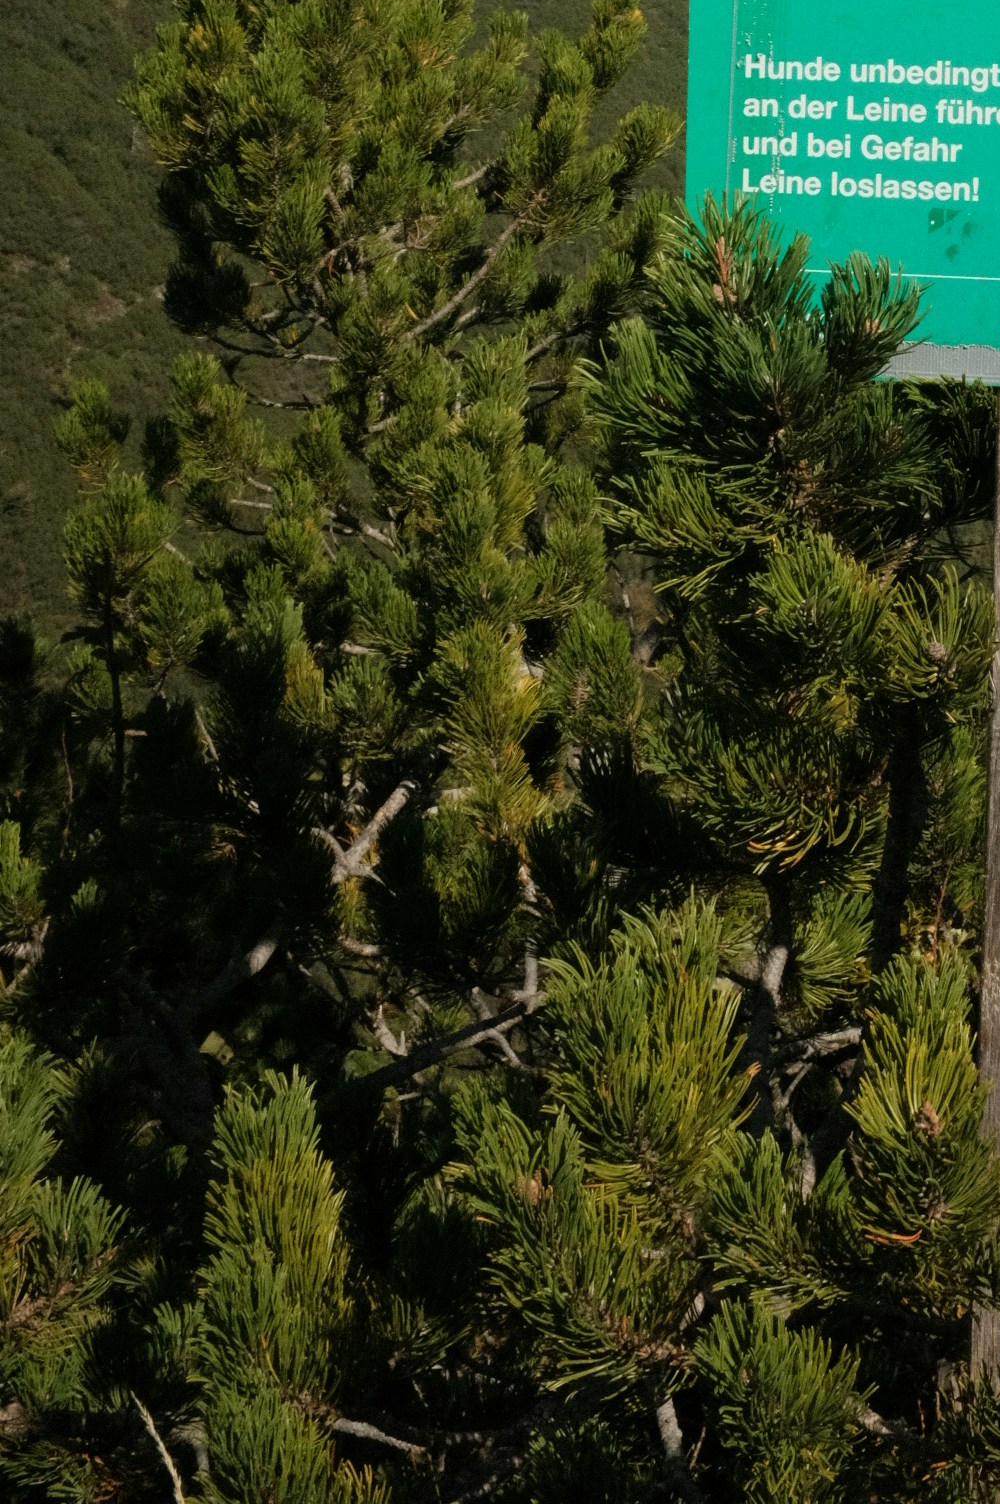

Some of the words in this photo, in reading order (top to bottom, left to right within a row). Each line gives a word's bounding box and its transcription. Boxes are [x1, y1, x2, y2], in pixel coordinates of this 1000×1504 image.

[744, 53, 842, 82] Hunde
[742, 97, 779, 118] an
[788, 93, 838, 120] der
[846, 95, 927, 123] Leine
[742, 132, 798, 157] und
[807, 132, 852, 159] bei
[860, 134, 963, 163] Gefahr
[741, 168, 822, 196] Leine
[831, 171, 980, 202] loslassen!
